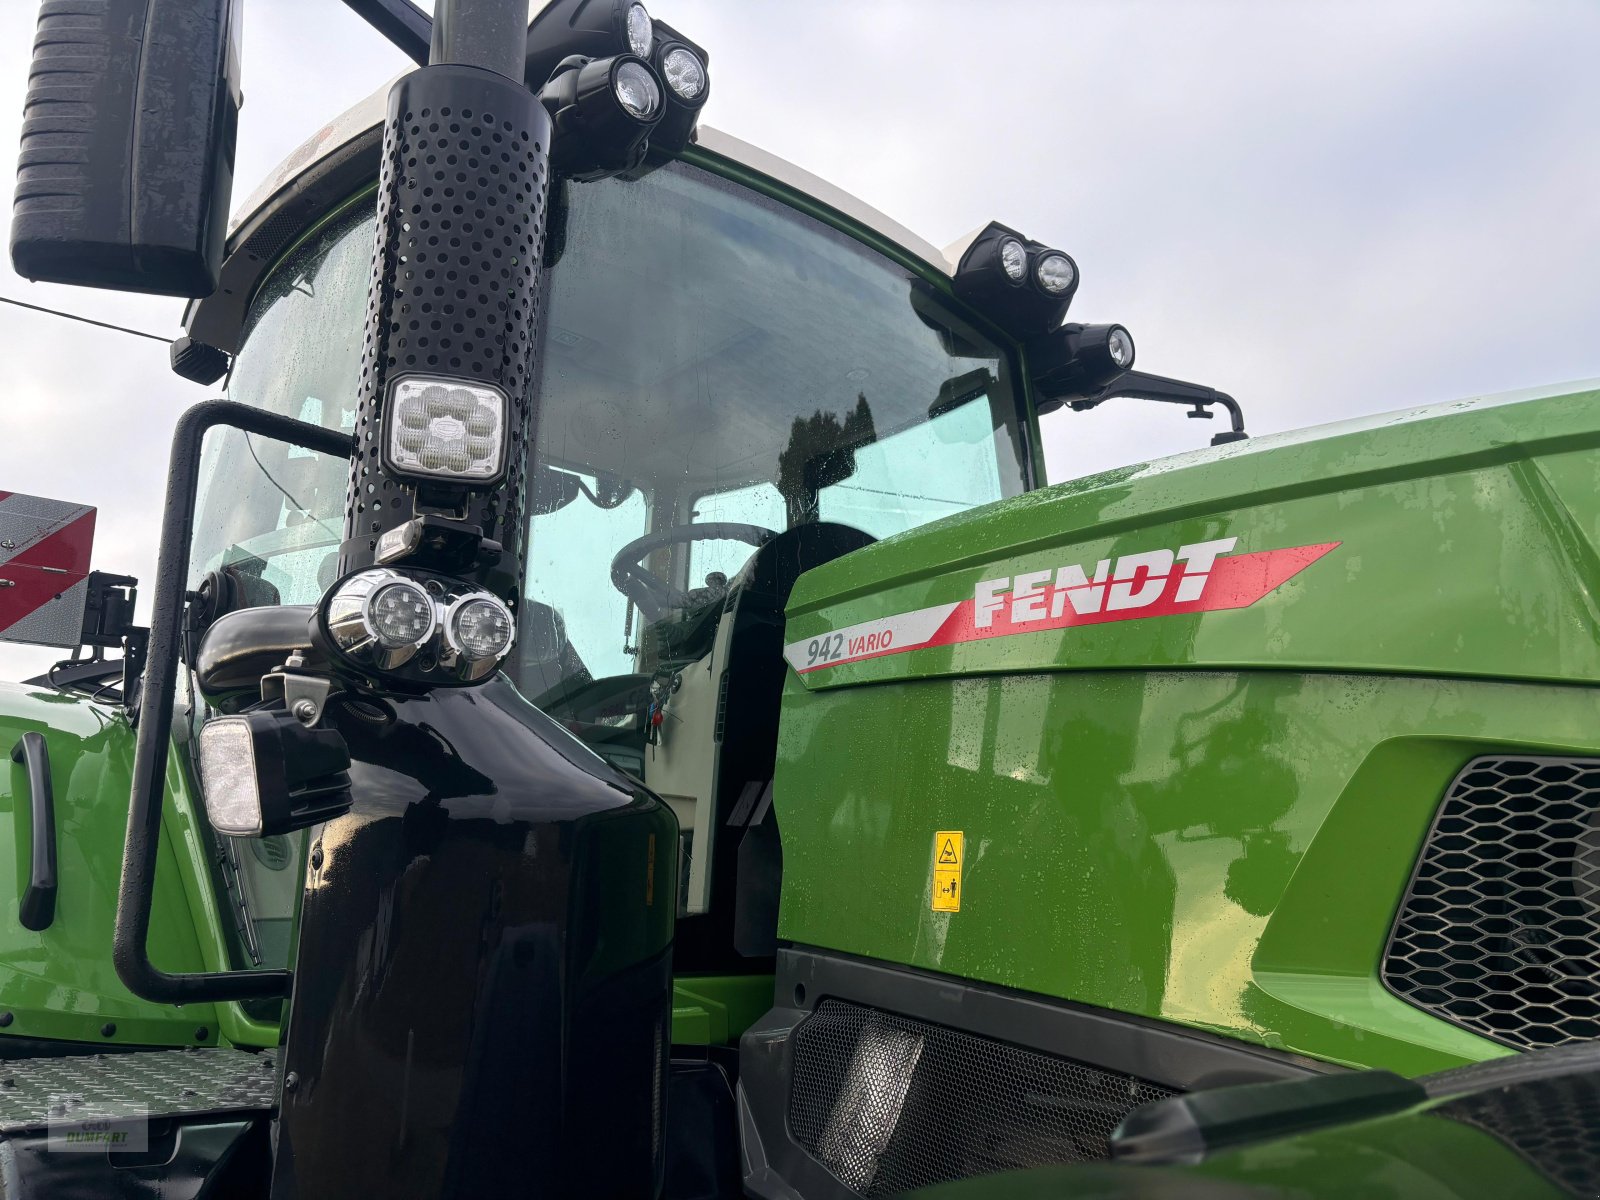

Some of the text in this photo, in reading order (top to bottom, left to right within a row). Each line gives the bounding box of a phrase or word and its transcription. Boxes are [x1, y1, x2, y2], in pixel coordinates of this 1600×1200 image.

[974, 537, 1237, 629] FENDT
[807, 629, 893, 667] 942 VARIO
